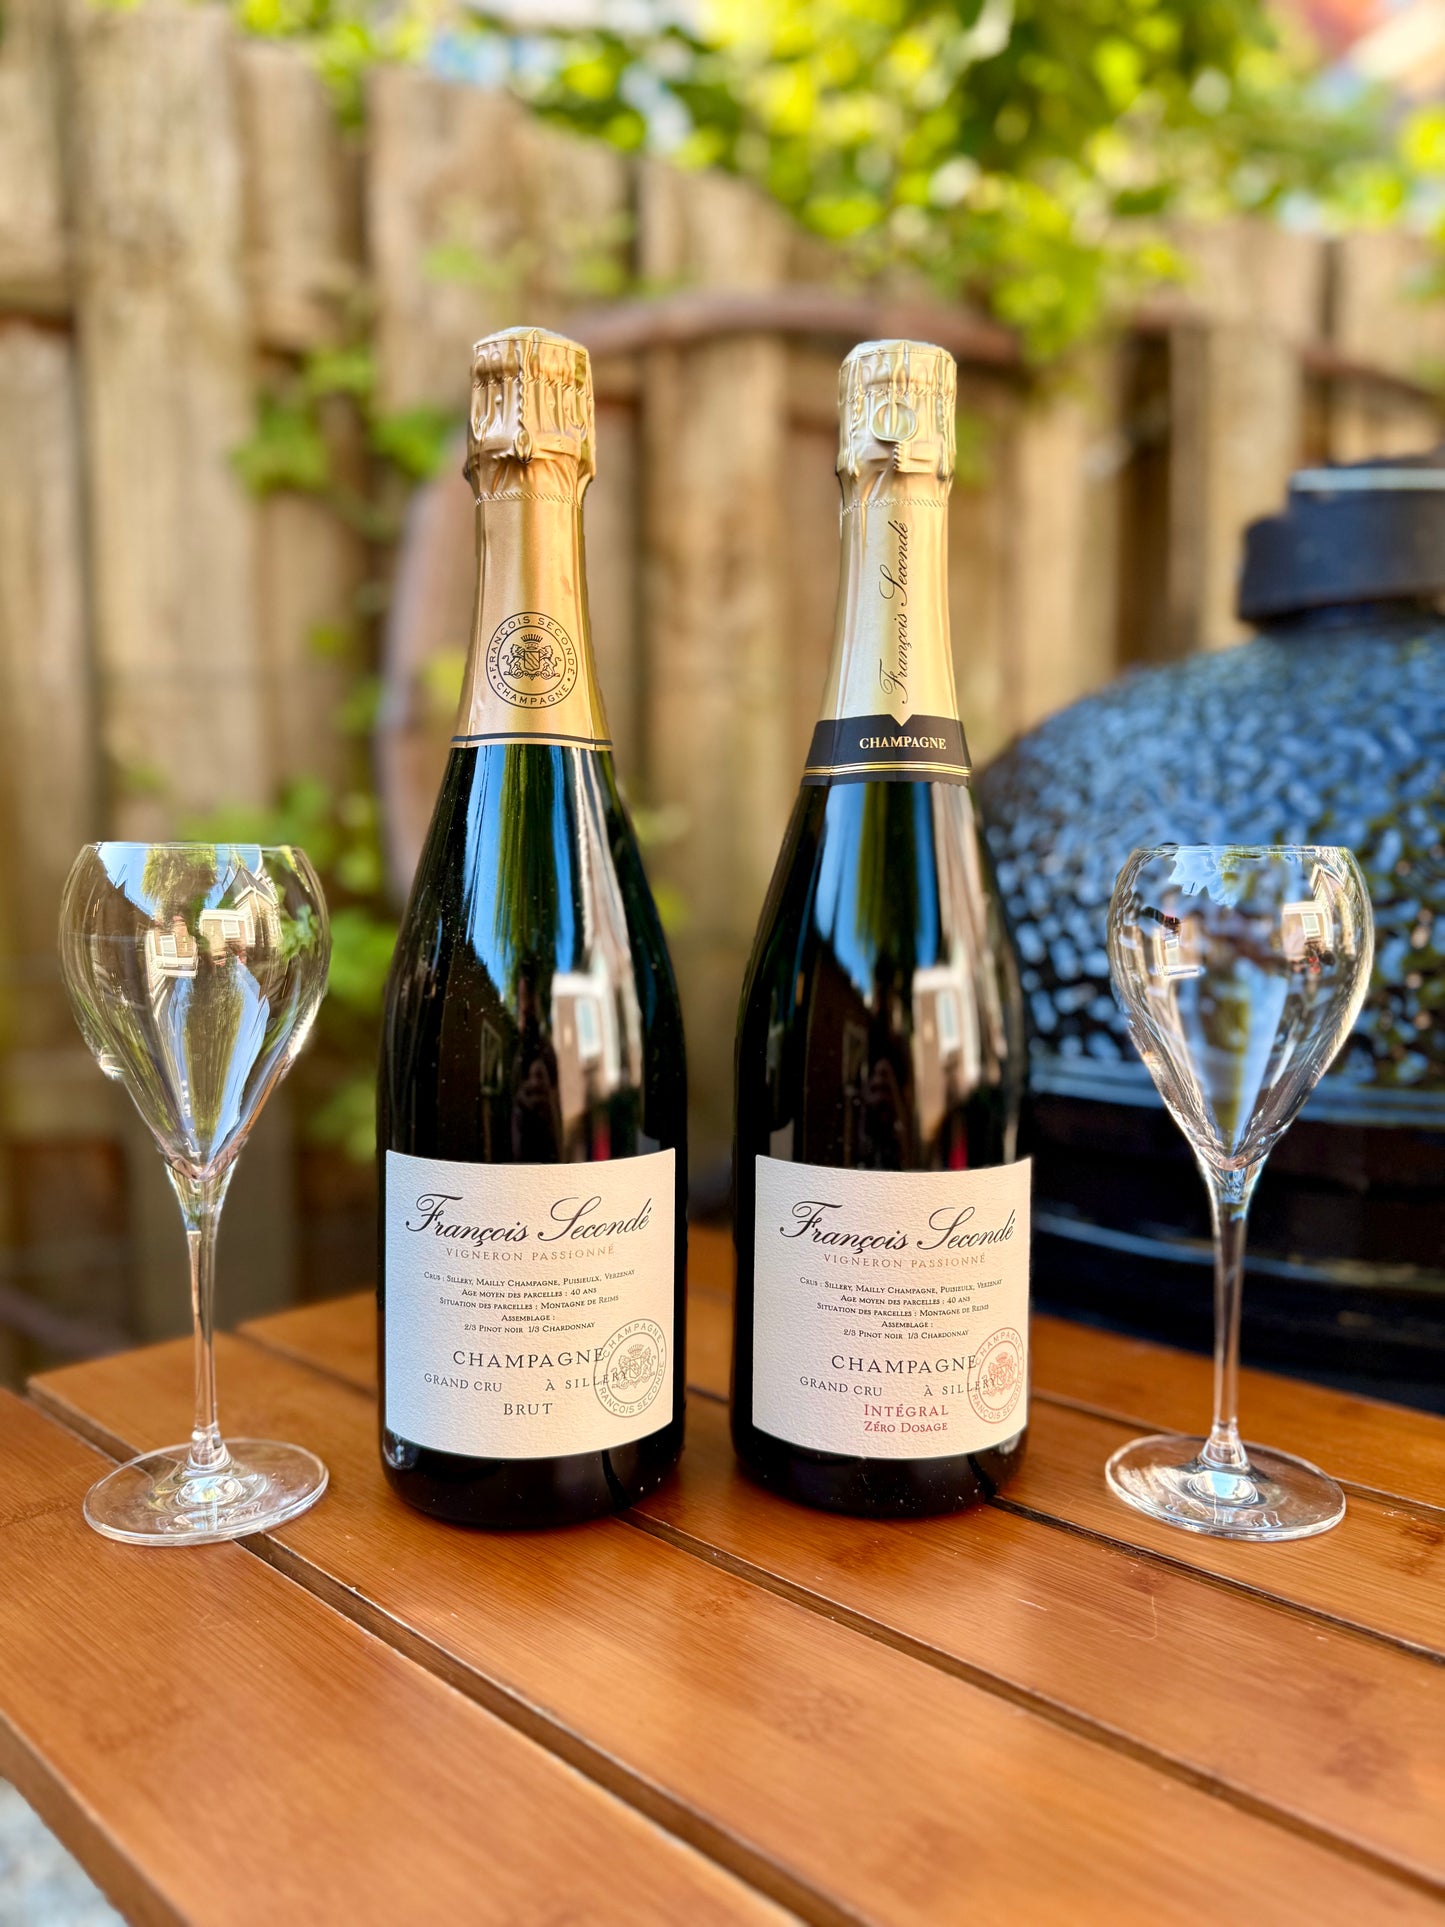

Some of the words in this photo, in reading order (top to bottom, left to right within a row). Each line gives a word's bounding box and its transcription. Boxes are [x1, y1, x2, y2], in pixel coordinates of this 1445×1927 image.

[878, 519, 909, 607] Secondé
[489, 615, 531, 673] FRANÇOIS
[878, 612, 913, 705] François
[496, 681, 569, 705] CHAMPAGNE
[859, 736, 947, 750] CHAMPAGNE
[405, 1193, 529, 1247] François
[537, 1195, 652, 1242] Secondé
[779, 1200, 909, 1254] François
[916, 1206, 1016, 1250] Secondé
[446, 1248, 523, 1261] VIGNERON
[532, 1244, 615, 1261] PASSIONNÉ
[823, 1253, 902, 1269] VIGNERON
[911, 1252, 986, 1269] PASSIONNÉ
[528, 1325, 540, 1333] 1/3
[908, 1332, 918, 1340] 1/3
[602, 1323, 663, 1358] CHAMPAGNE
[452, 1348, 605, 1368] CHAMPAGNE
[831, 1354, 977, 1374] CHAMPAGNE
[424, 1373, 469, 1389] GRAND
[474, 1382, 502, 1392] CRU
[545, 1378, 555, 1391] À
[565, 1370, 628, 1390] SILLERY
[799, 1376, 848, 1393] GRAND
[853, 1385, 882, 1397] CRU
[923, 1384, 933, 1397] À
[941, 1377, 997, 1396] SILLERY
[503, 1403, 553, 1416] BRUT
[864, 1403, 949, 1418] INTÉGRAL
[971, 1387, 1001, 1420] RANÇOIS
[901, 1421, 948, 1433] DOSAGE
